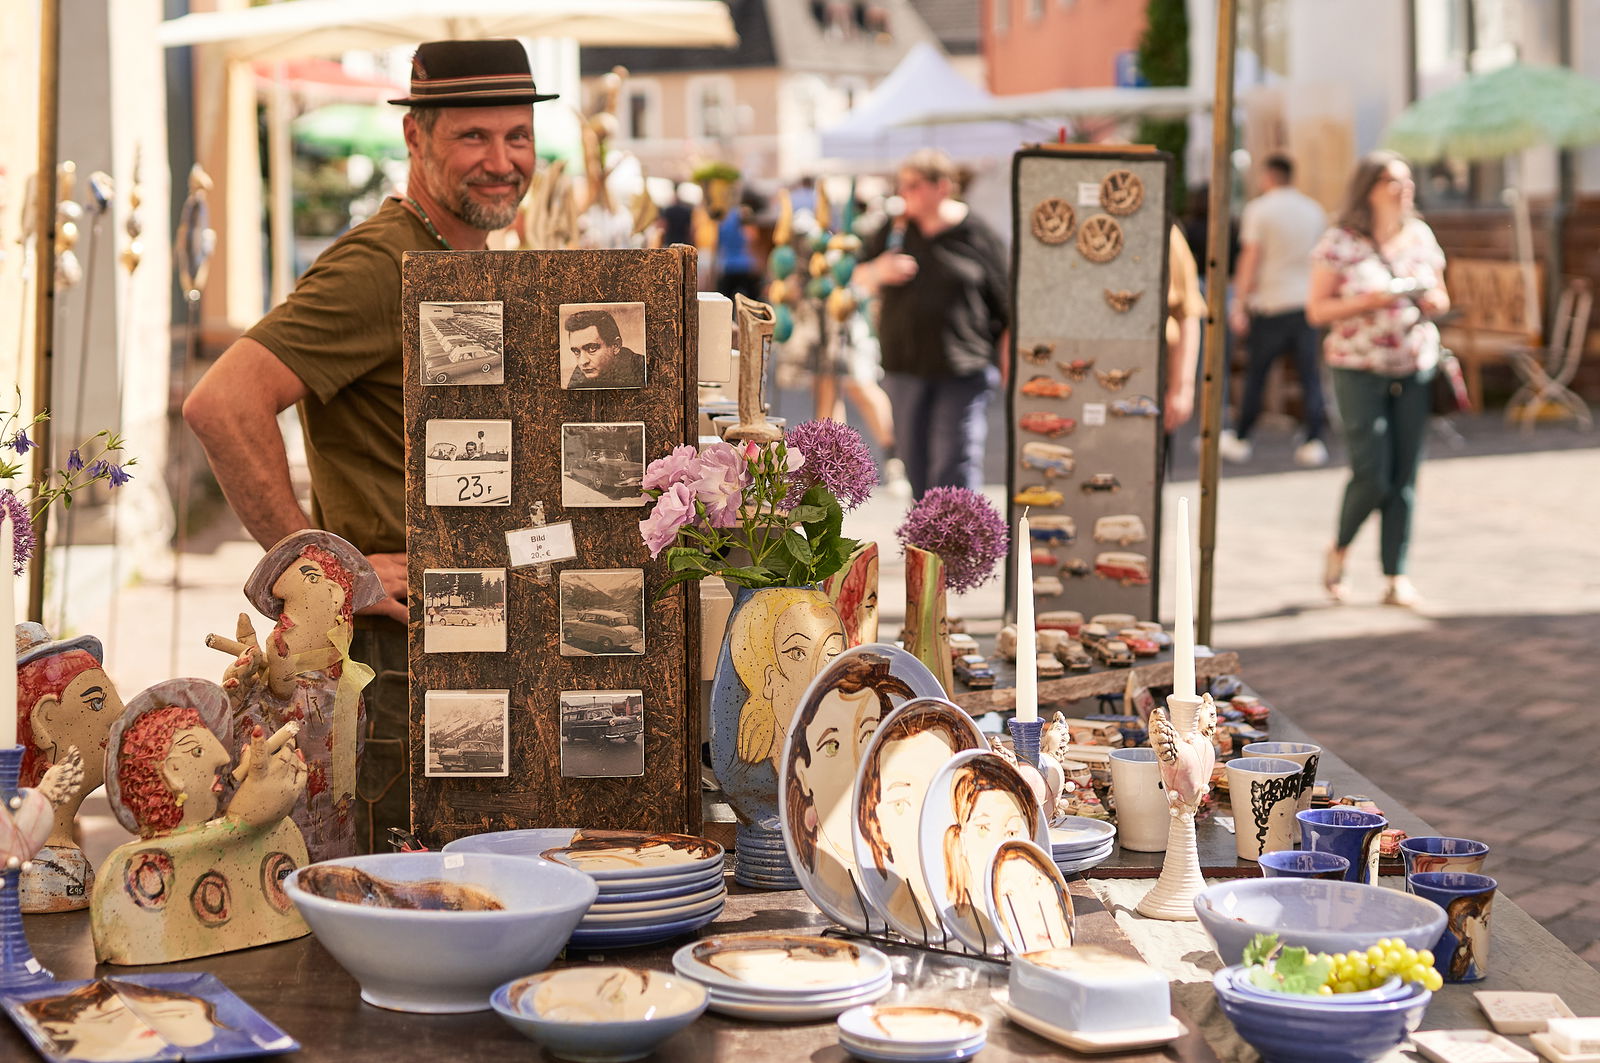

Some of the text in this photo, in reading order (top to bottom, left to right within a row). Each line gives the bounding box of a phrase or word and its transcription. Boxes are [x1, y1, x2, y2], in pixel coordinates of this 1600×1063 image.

[457, 475, 492, 501] 23 F
[530, 534, 546, 543] Bild
[536, 543, 543, 551] je
